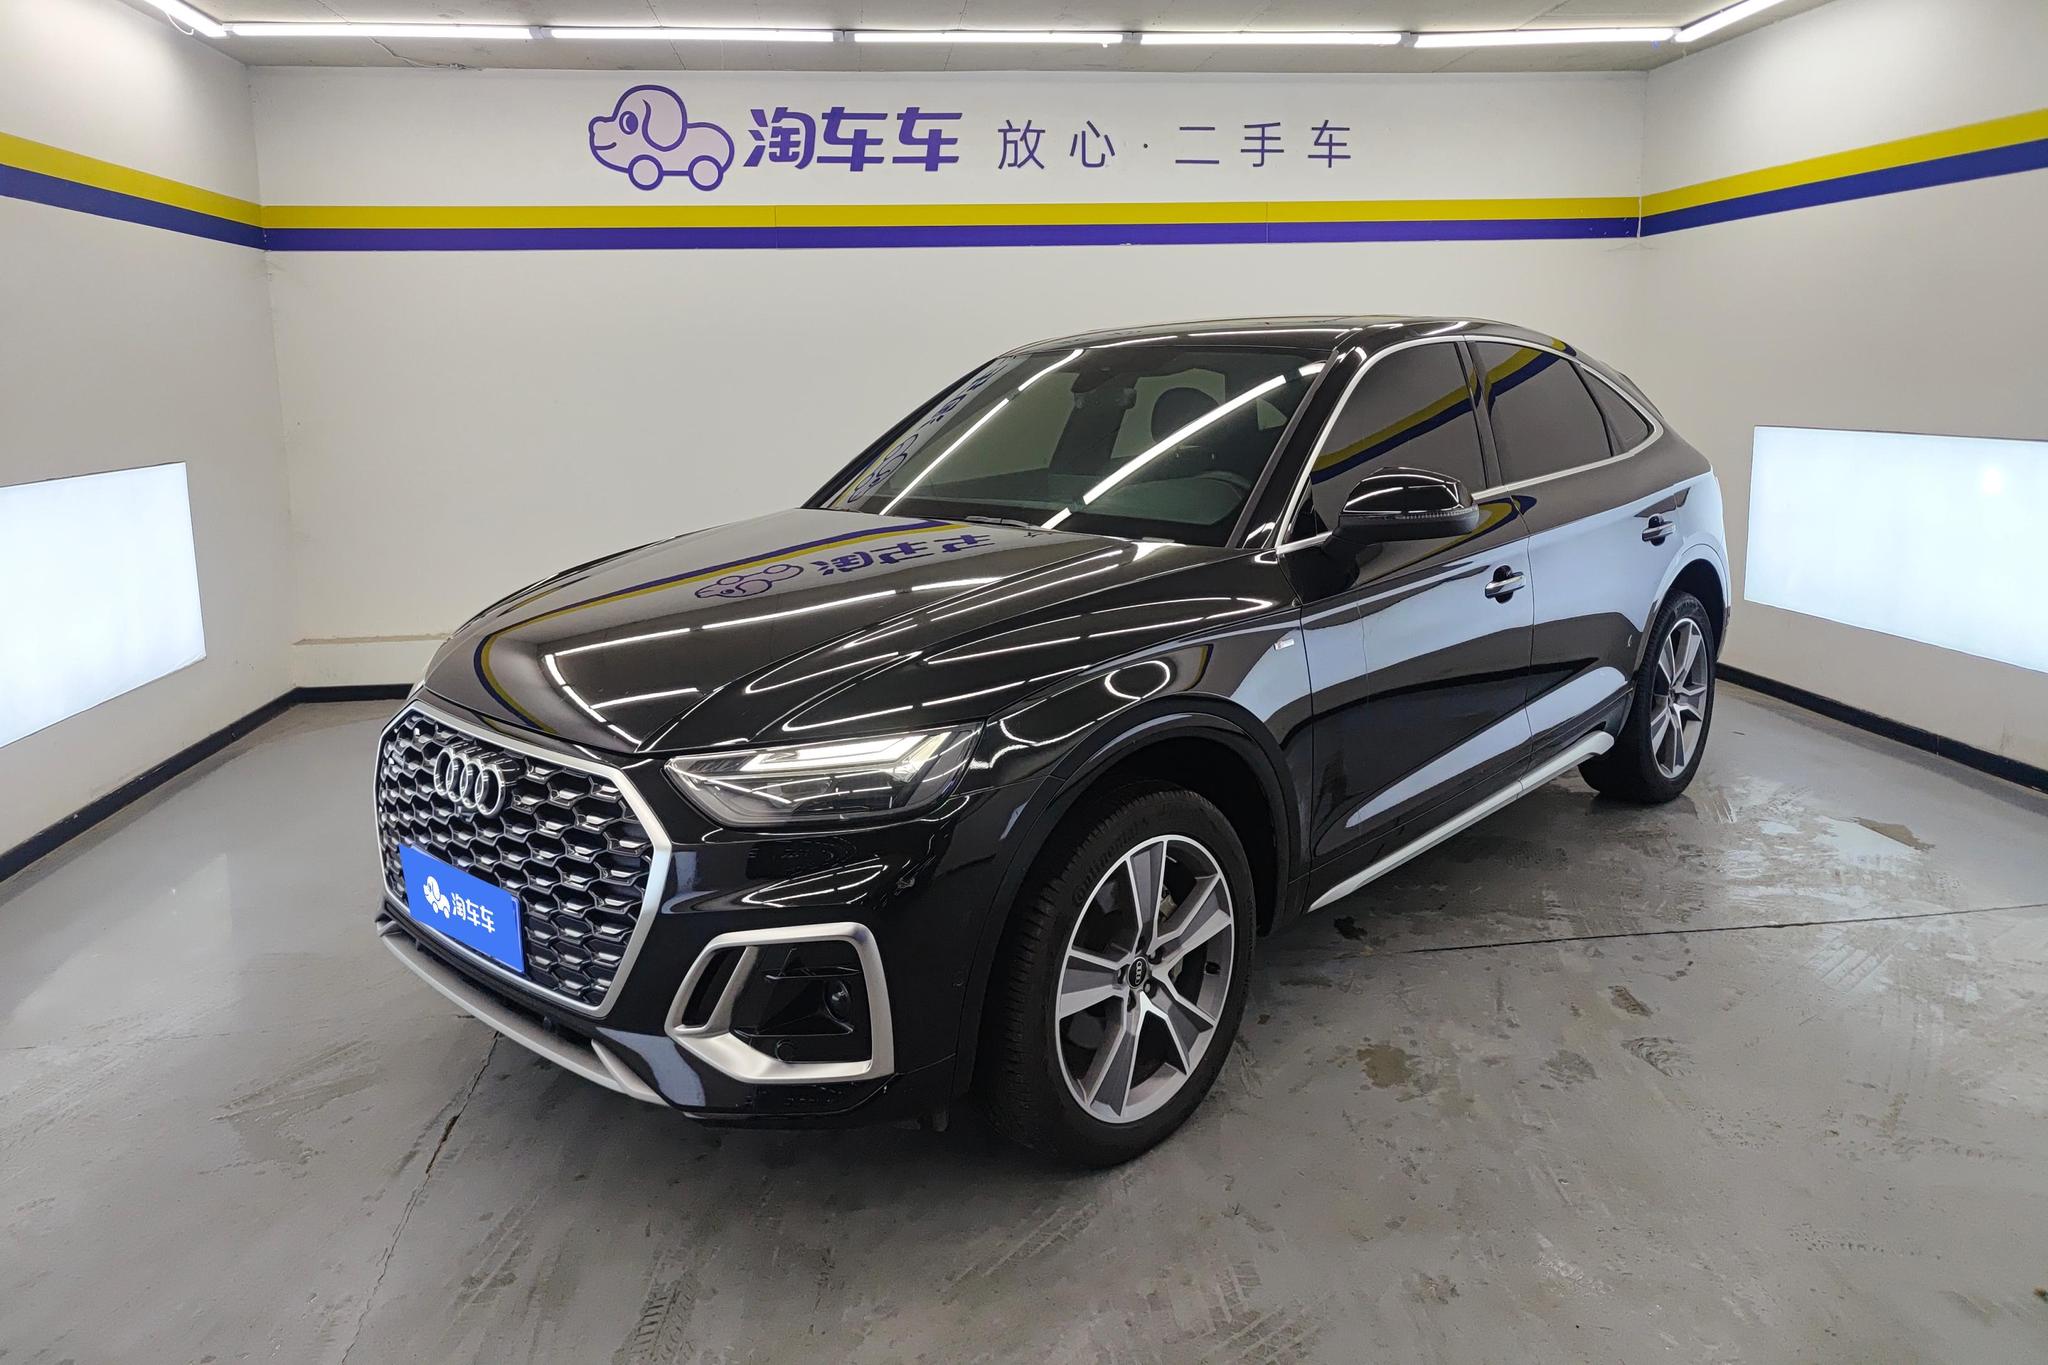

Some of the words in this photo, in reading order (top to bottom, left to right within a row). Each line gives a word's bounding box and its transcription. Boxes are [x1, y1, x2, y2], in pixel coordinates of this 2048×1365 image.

[743, 107, 963, 172] 淘车车
[998, 120, 1352, 170] 放心·二手车
[451, 892, 496, 934] 淘车车
